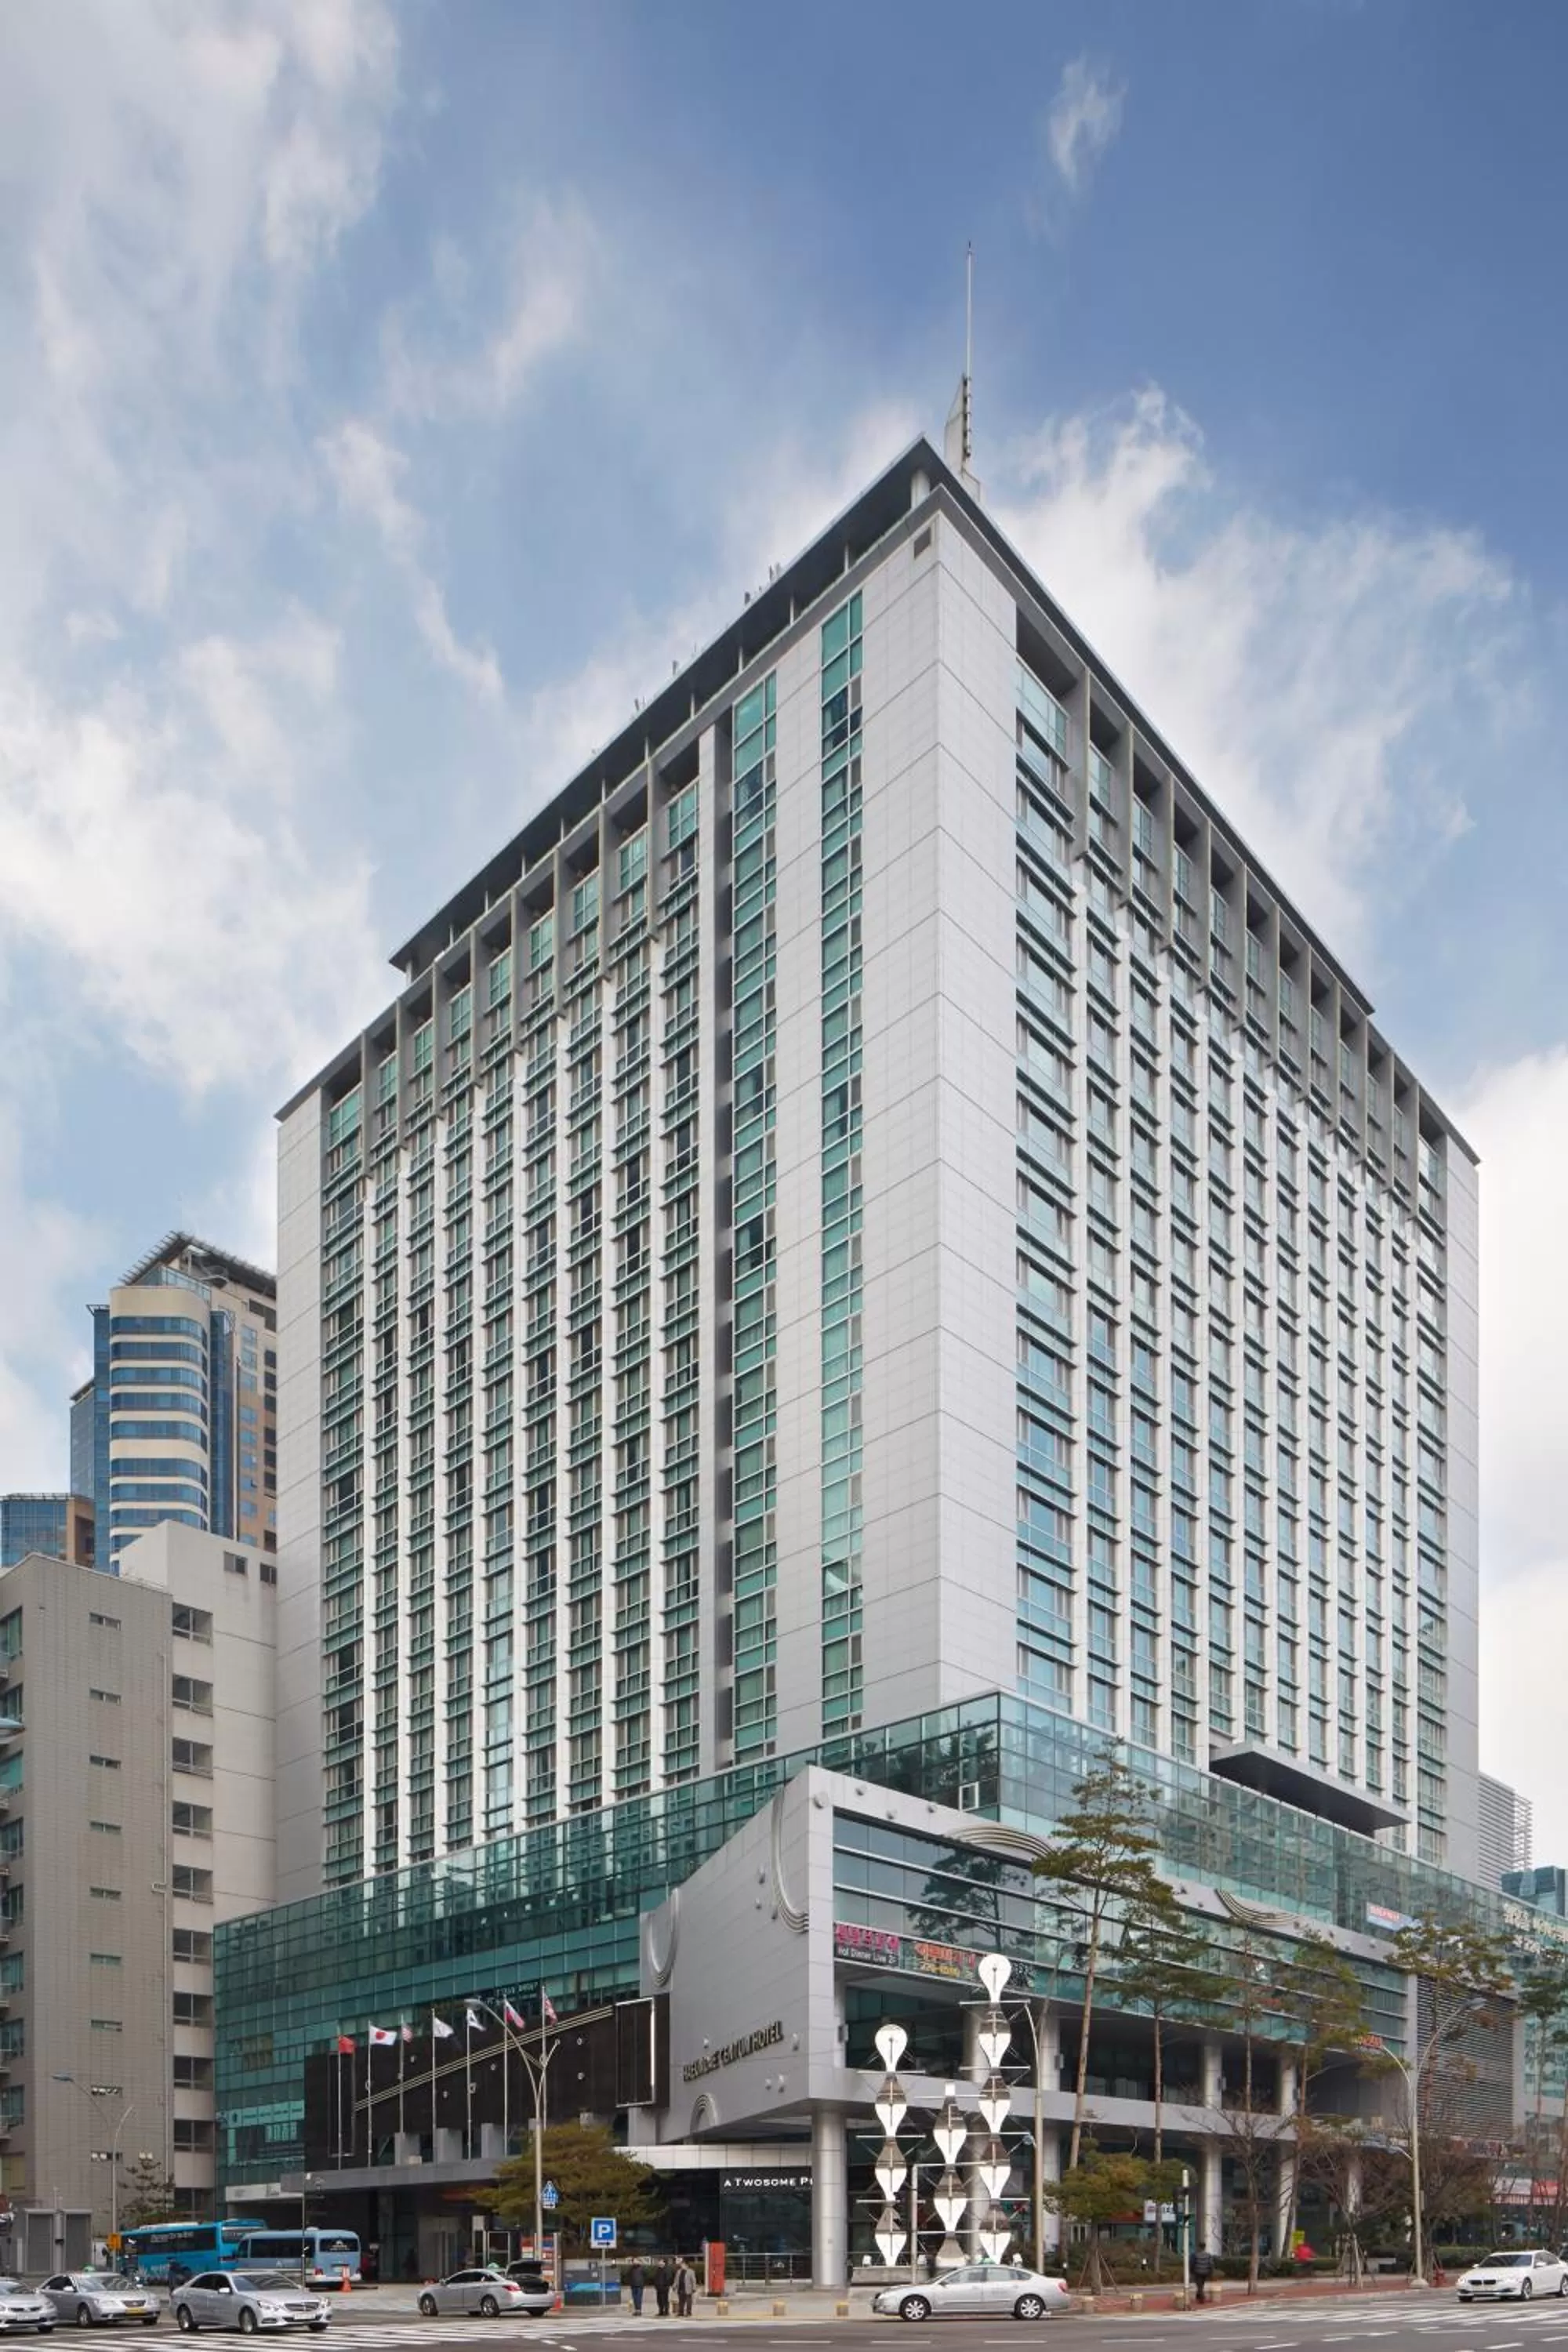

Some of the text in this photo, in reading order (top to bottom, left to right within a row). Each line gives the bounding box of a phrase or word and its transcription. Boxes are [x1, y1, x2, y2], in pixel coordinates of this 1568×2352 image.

[753, 2020, 784, 2052] HOTEL
[724, 2179, 731, 2187] A
[735, 2177, 797, 2187] TWOSOME
[597, 2224, 612, 2238] P
